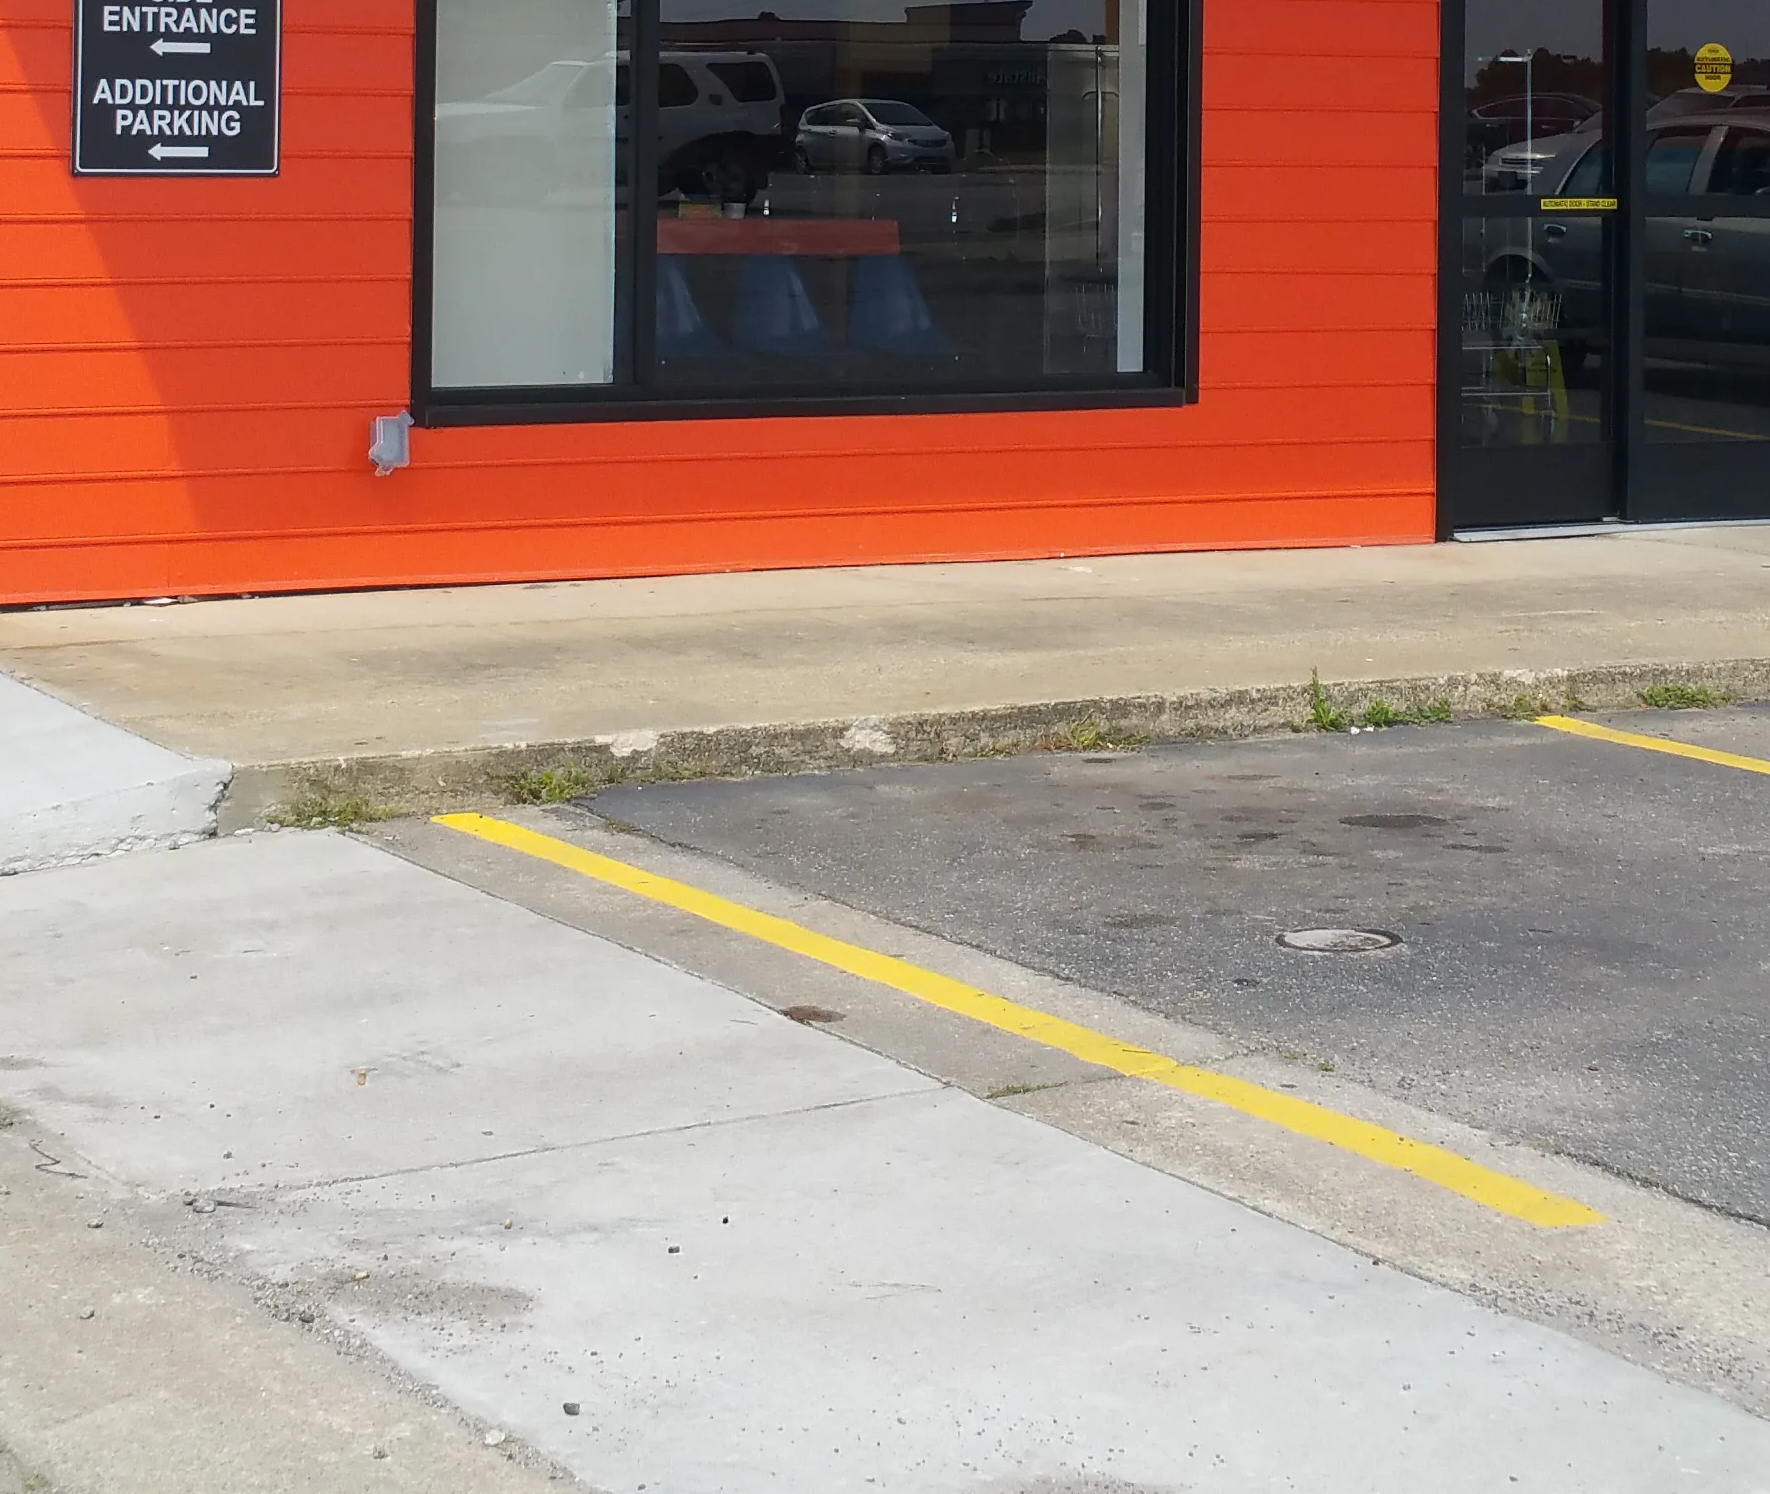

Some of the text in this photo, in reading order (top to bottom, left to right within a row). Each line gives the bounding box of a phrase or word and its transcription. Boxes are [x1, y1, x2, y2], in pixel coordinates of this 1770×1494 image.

[102, 5, 257, 35] ENTRANCE
[1695, 64, 1732, 74] CAUTION
[92, 78, 265, 107] ADDITIONAL
[115, 109, 241, 137] PARKING
